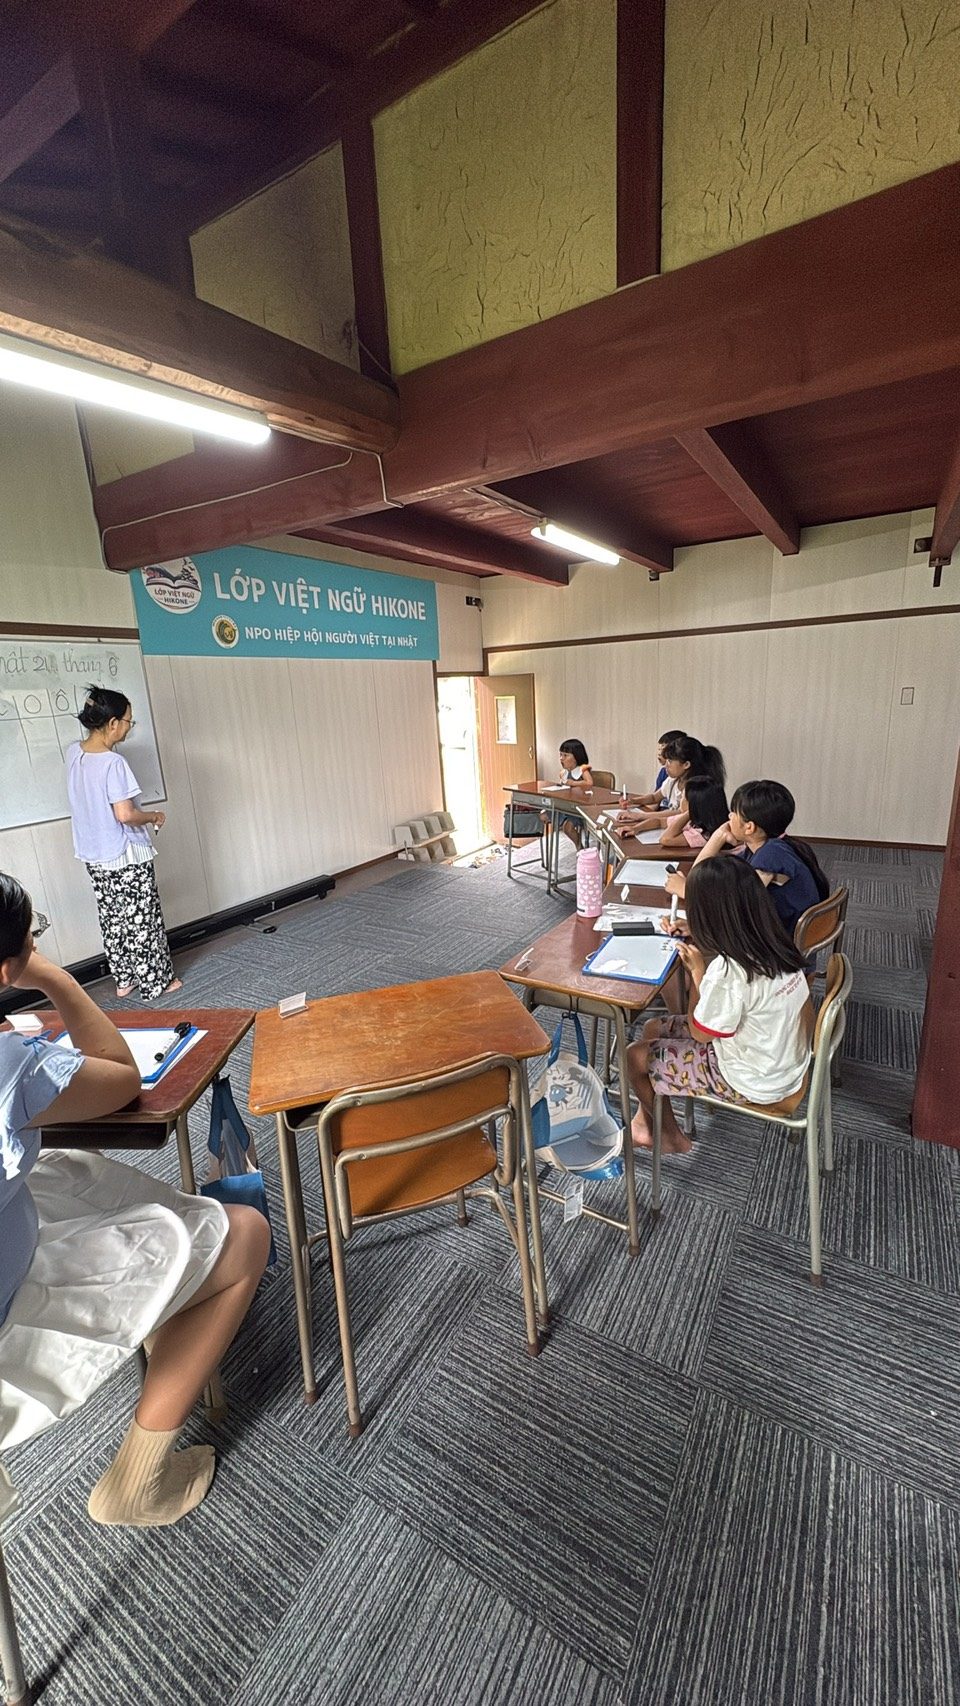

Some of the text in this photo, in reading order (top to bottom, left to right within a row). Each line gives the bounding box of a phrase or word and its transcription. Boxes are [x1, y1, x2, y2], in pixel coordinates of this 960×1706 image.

[213, 568, 426, 620] LỚP VIỆT NGỮ HIKONE
[245, 626, 418, 649] NPO HIỆP HỘI NGƯỜI VIỆT TẠI NHẬT
[108, 656, 119, 677] 6
[54, 688, 70, 711] Ô
